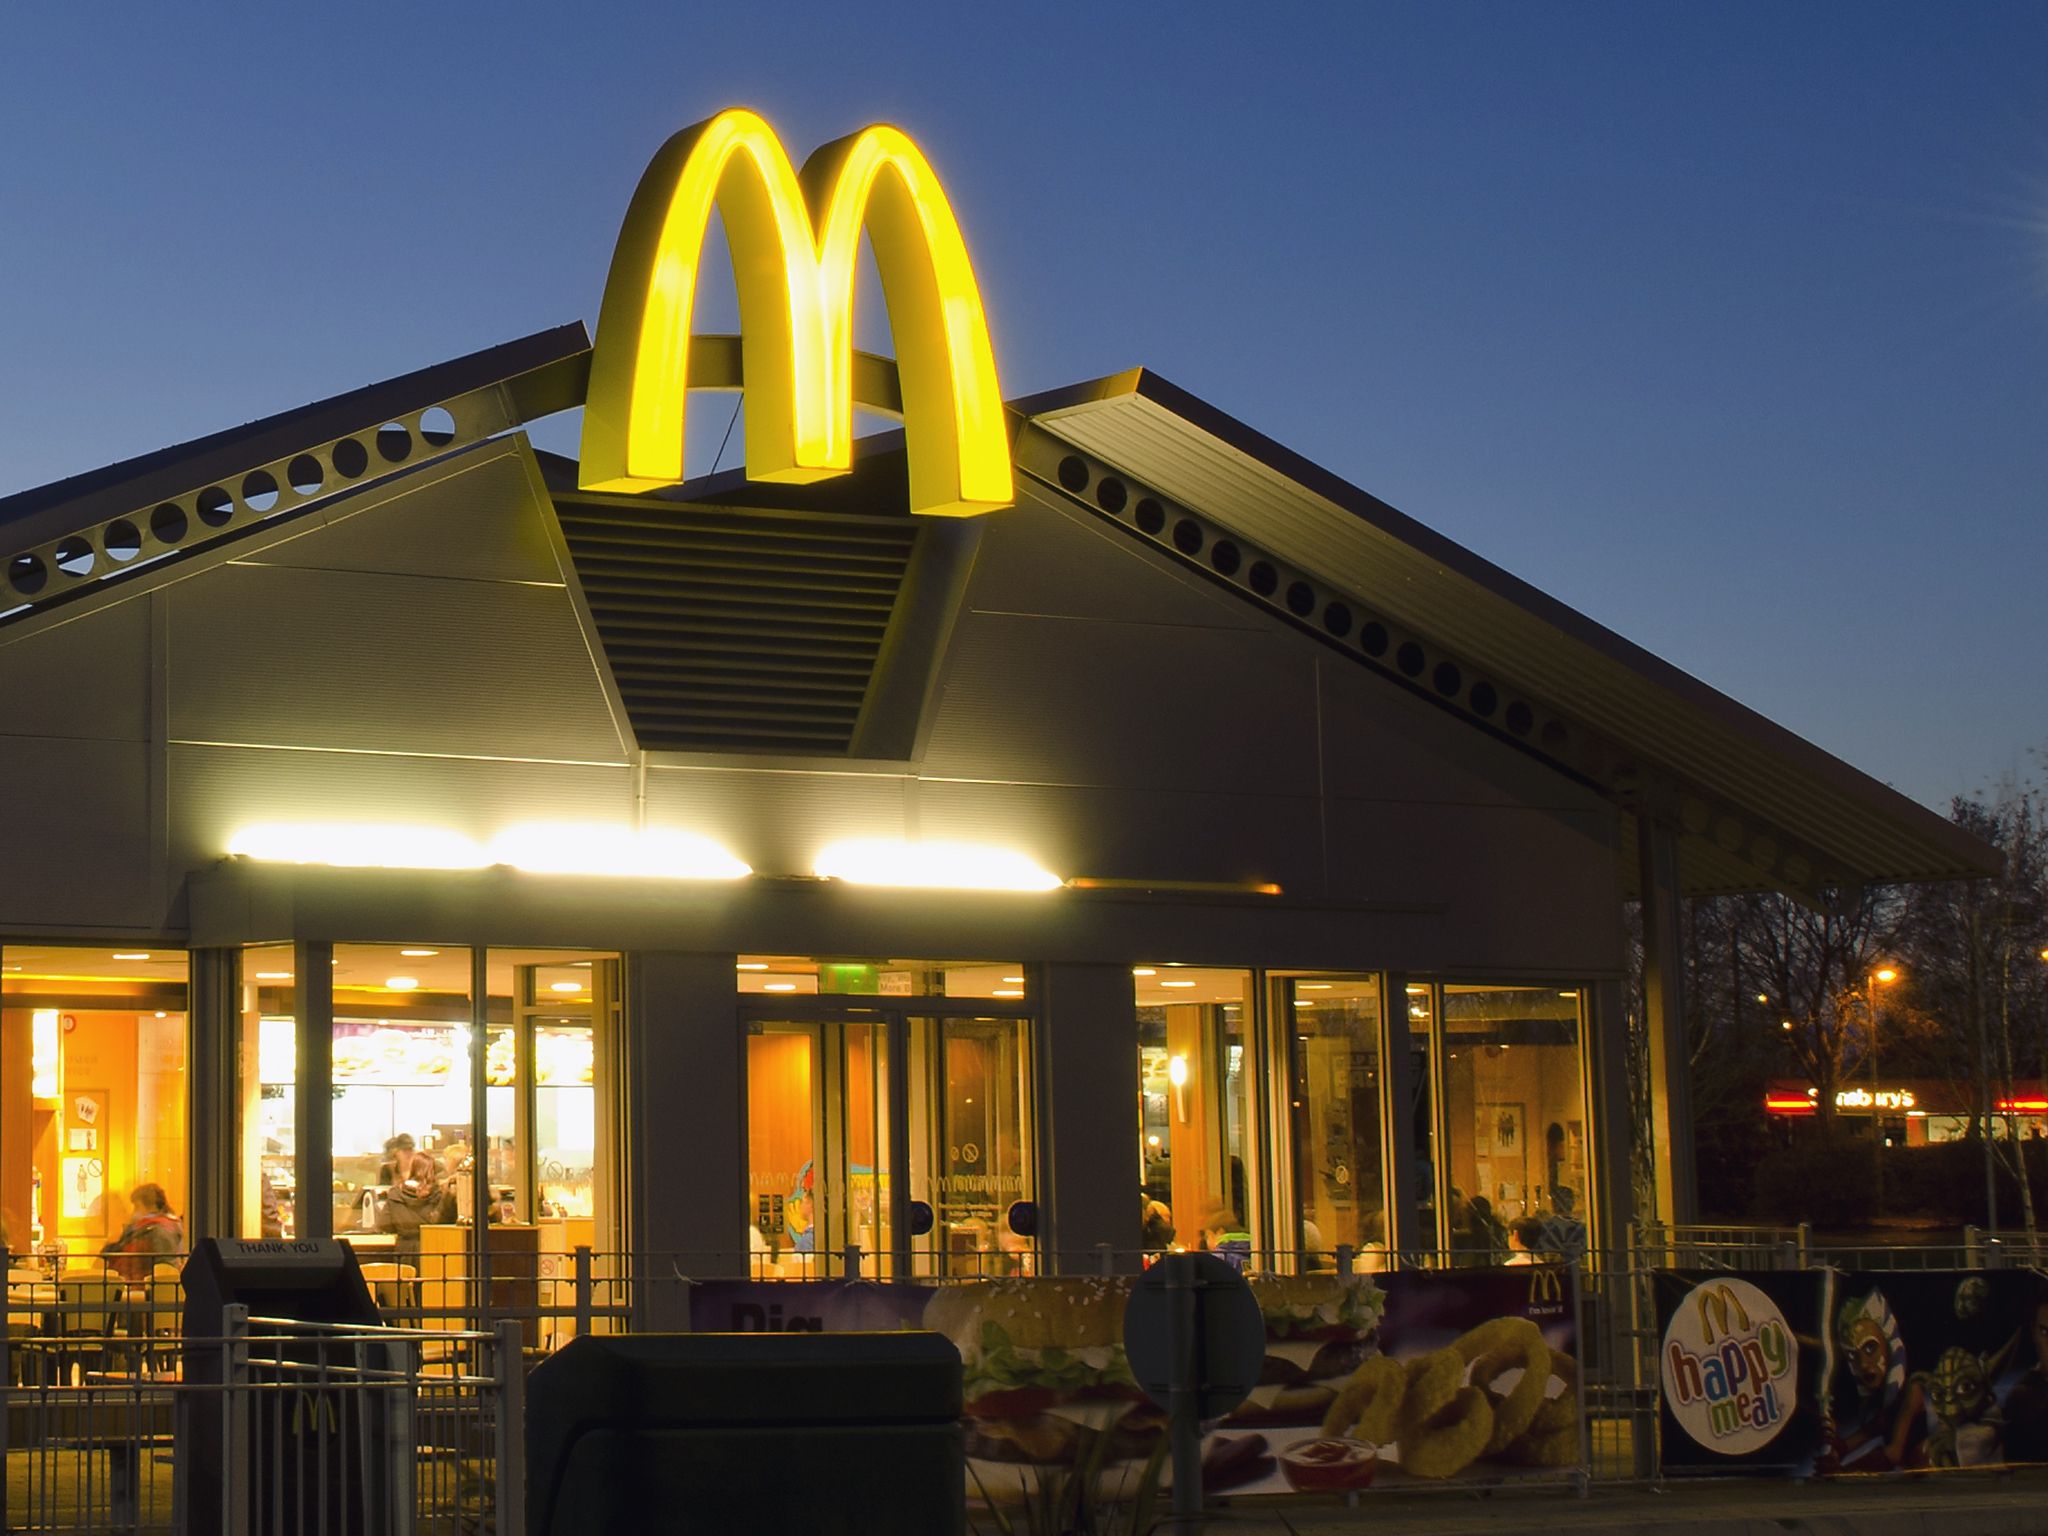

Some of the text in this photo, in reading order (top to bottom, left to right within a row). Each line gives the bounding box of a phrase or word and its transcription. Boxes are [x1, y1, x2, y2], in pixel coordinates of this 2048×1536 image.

[1807, 1087, 1915, 1109] Snsbury's
[237, 1242, 319, 1254] THANK YOU
[1670, 1321, 1789, 1403] happy
[1711, 1383, 1778, 1434] meal
